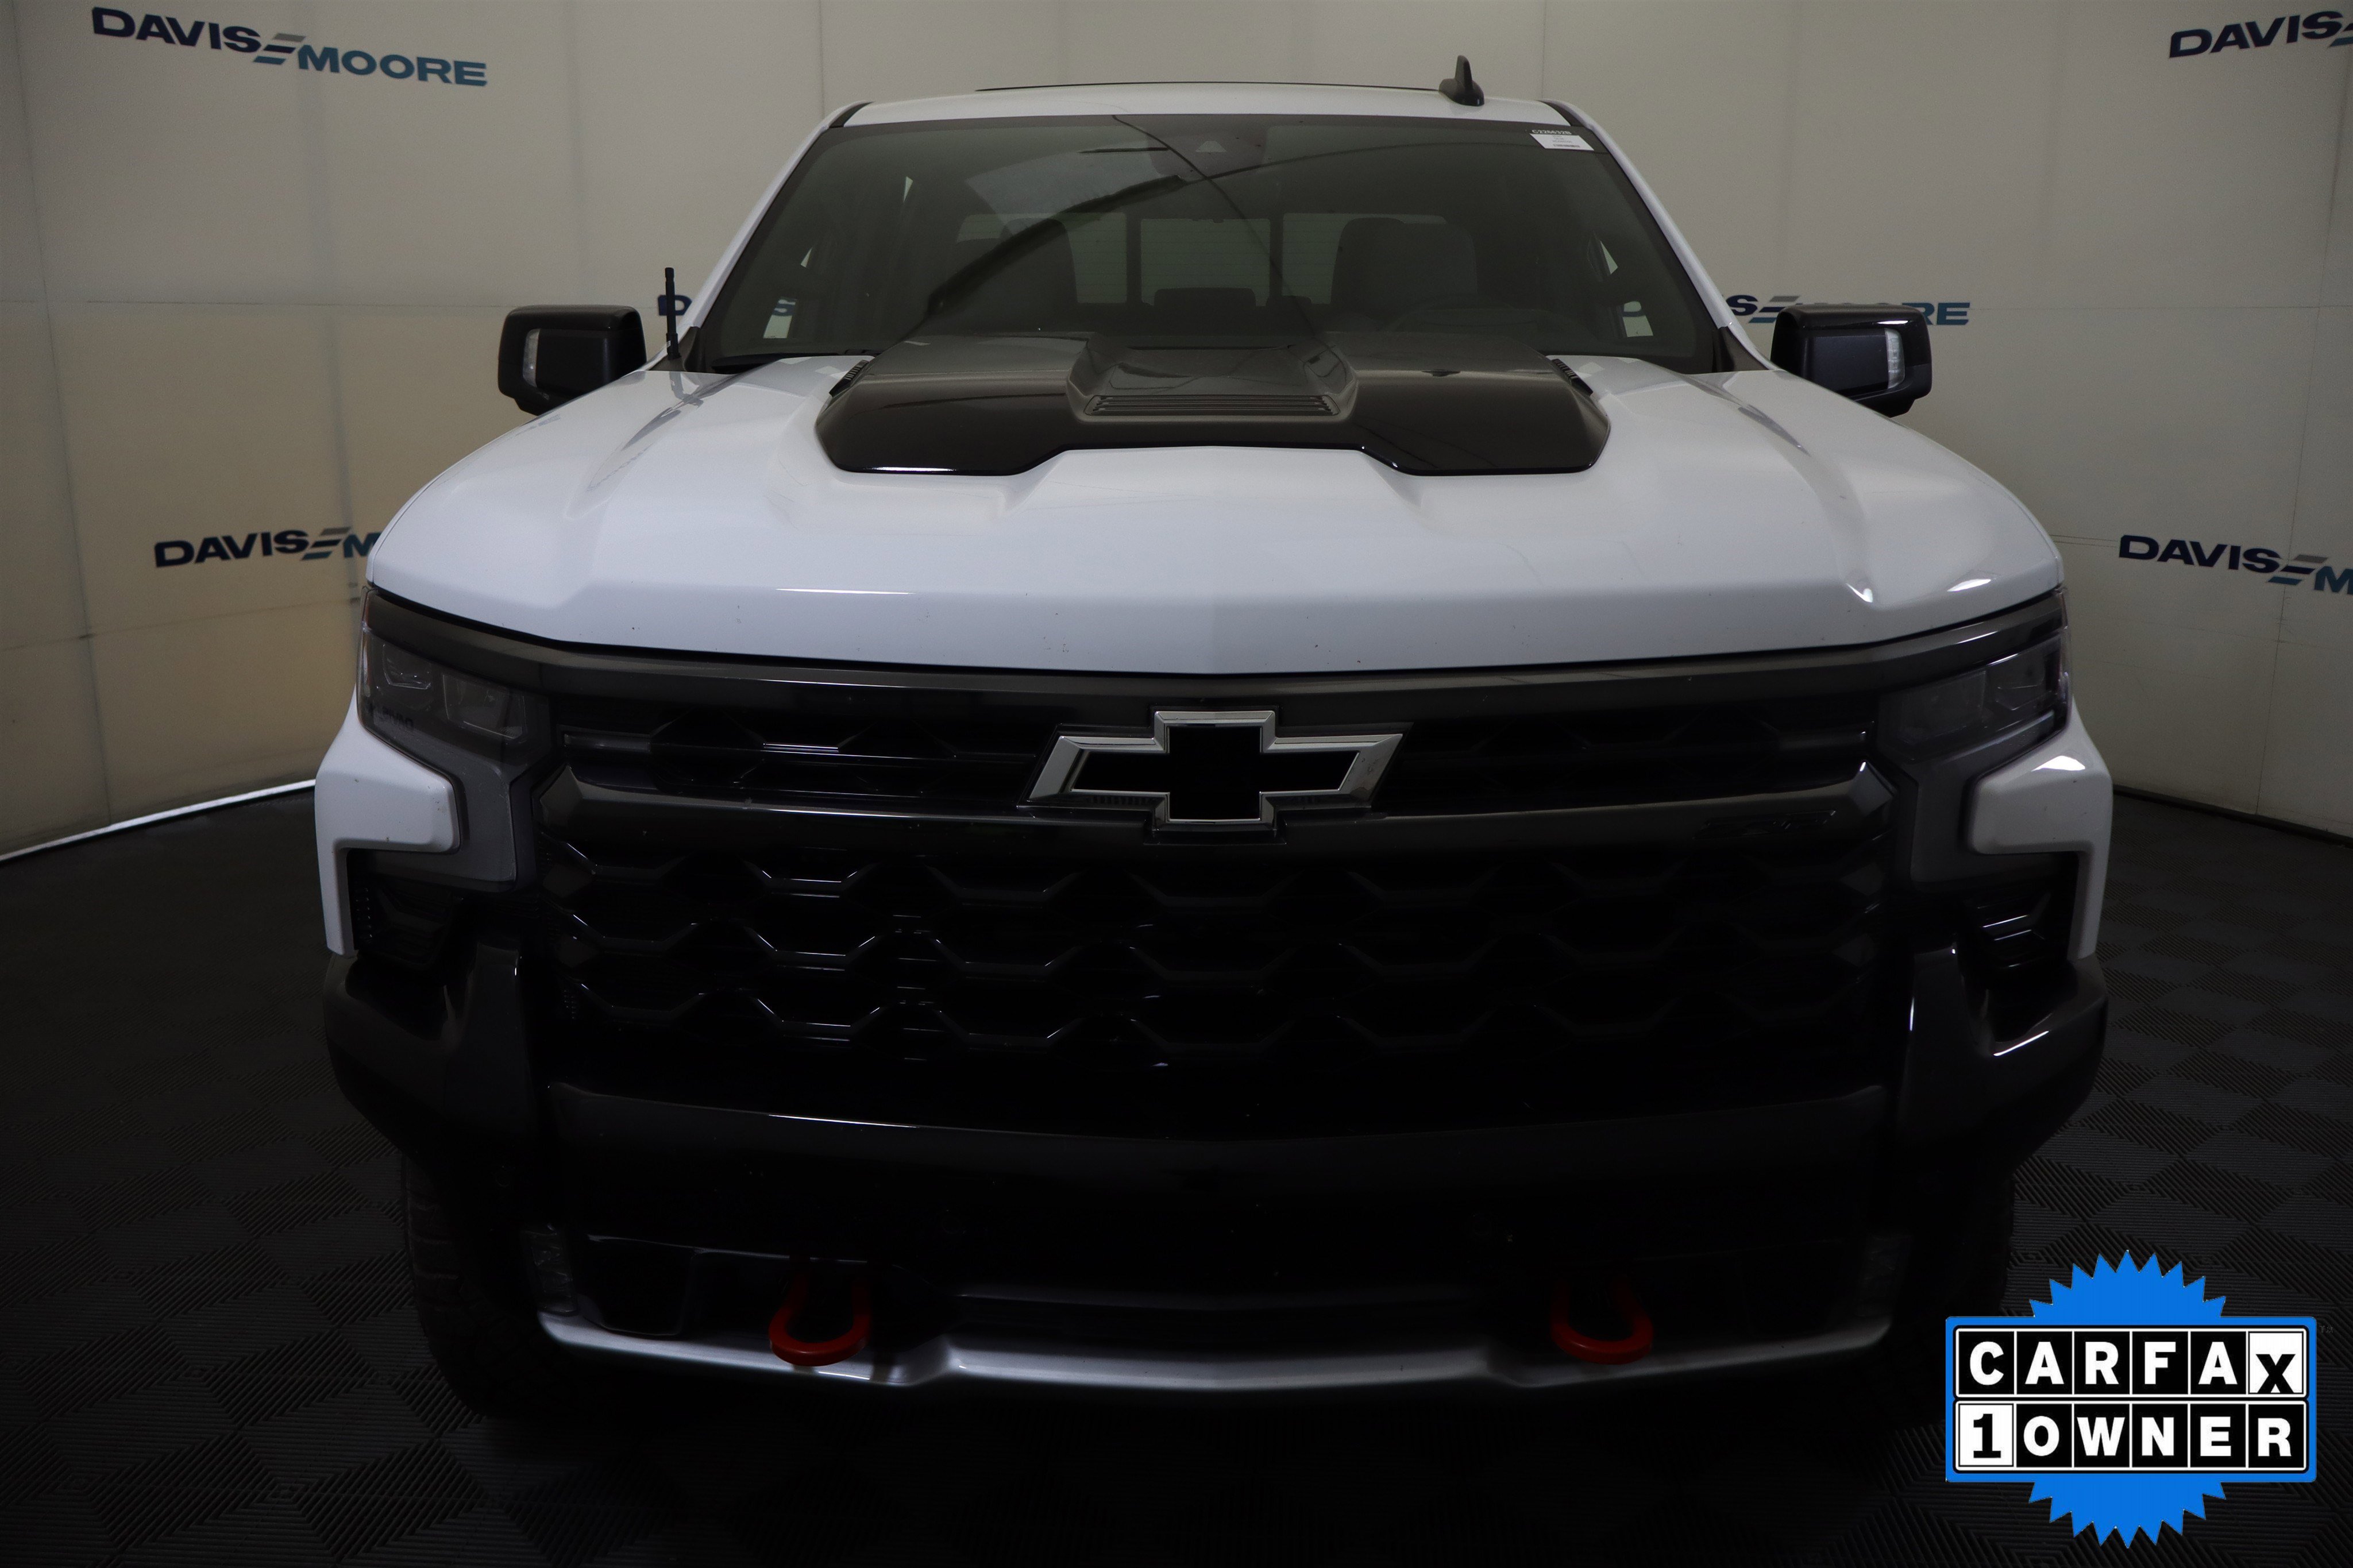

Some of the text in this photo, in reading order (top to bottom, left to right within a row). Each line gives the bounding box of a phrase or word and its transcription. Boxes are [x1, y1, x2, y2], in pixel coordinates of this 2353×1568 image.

[92, 7, 487, 87] DAVIS MOORE
[2169, 10, 2344, 58] DAVIS
[154, 530, 310, 567] DAVIS
[2119, 535, 2282, 574] DAVIS
